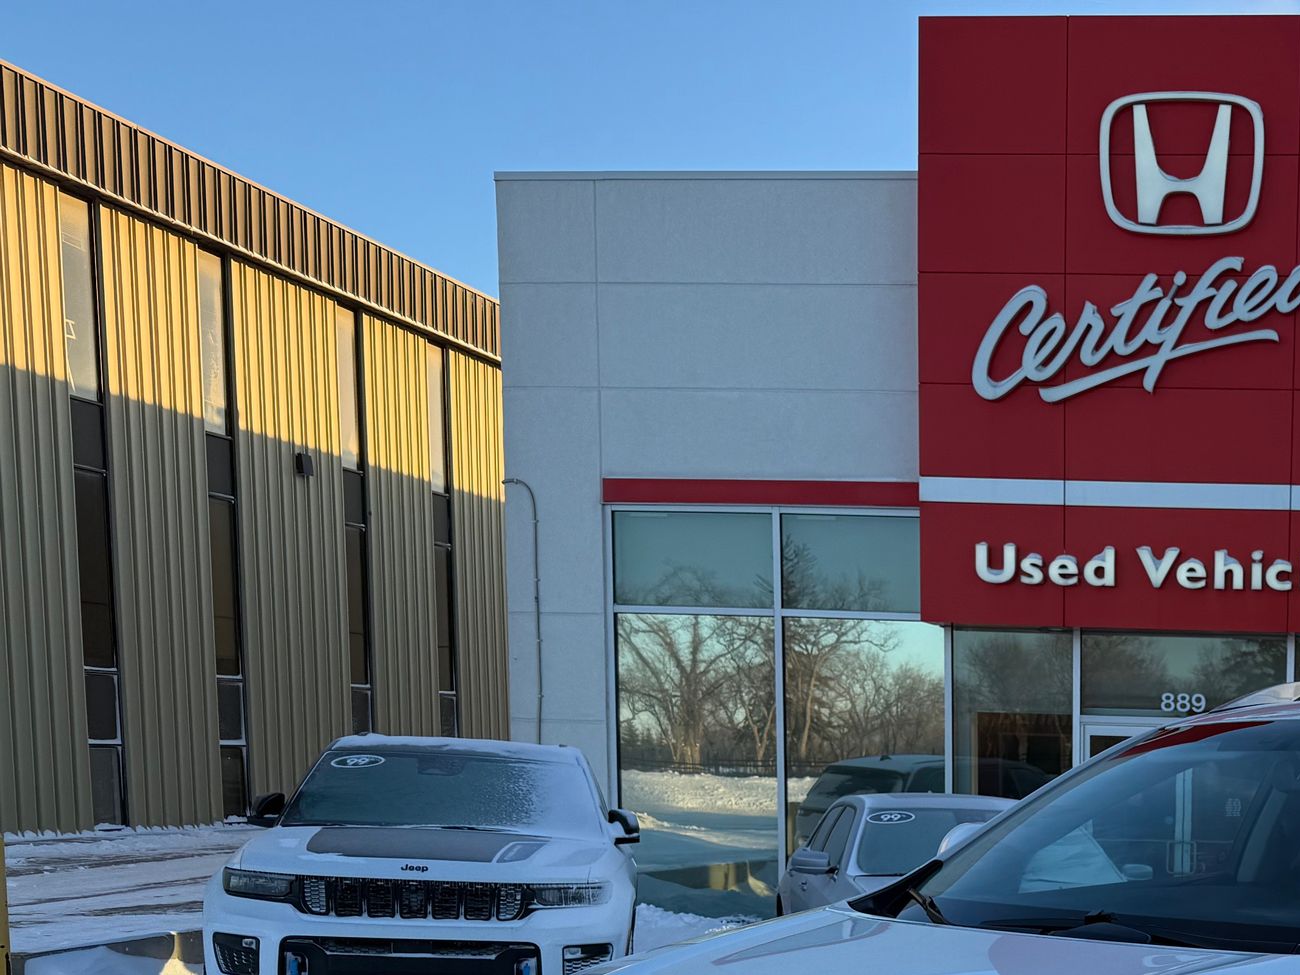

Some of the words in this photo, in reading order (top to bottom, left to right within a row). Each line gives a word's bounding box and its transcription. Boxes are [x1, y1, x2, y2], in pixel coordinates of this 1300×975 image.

[975, 541, 1116, 585] Used
[1160, 692, 1206, 713] 889
[400, 863, 429, 873] Jeep
